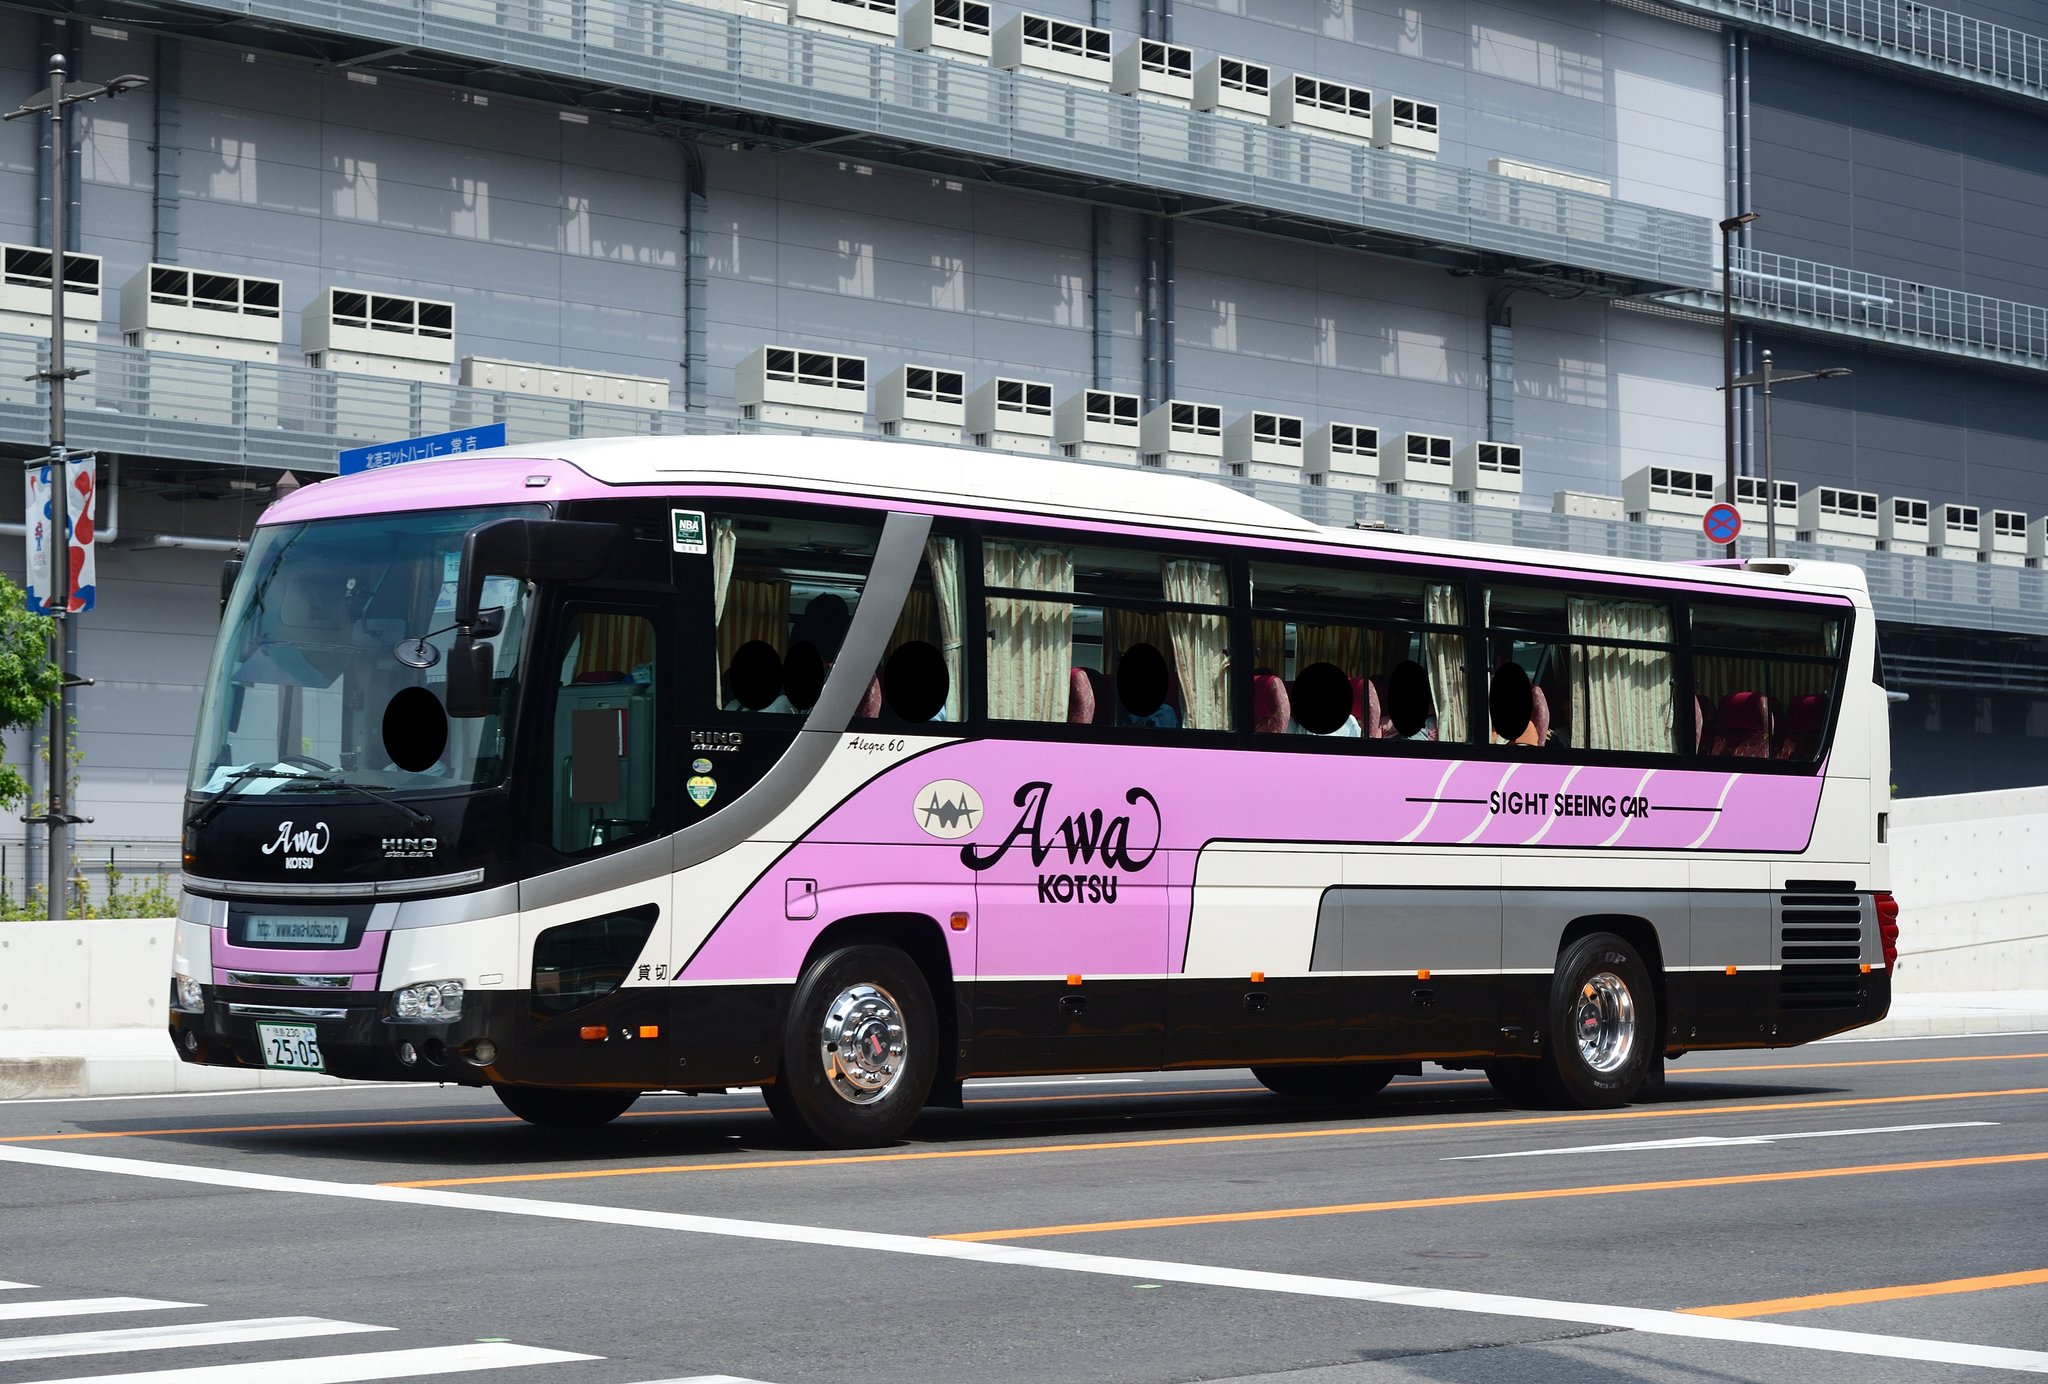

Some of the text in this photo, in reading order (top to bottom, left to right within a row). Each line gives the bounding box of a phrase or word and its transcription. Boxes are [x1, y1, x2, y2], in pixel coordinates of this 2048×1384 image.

[679, 519, 699, 531] NBA
[690, 731, 743, 744] HINO
[846, 736, 905, 755] Alegre 60
[1490, 790, 1649, 819] SIGHT SEEING CAR
[960, 781, 1162, 873] Awa
[261, 821, 330, 855] Awa
[381, 837, 438, 850] HINO
[285, 857, 314, 870] KOTSU
[1037, 874, 1118, 904] KOTSU
[637, 963, 668, 981] 貸切
